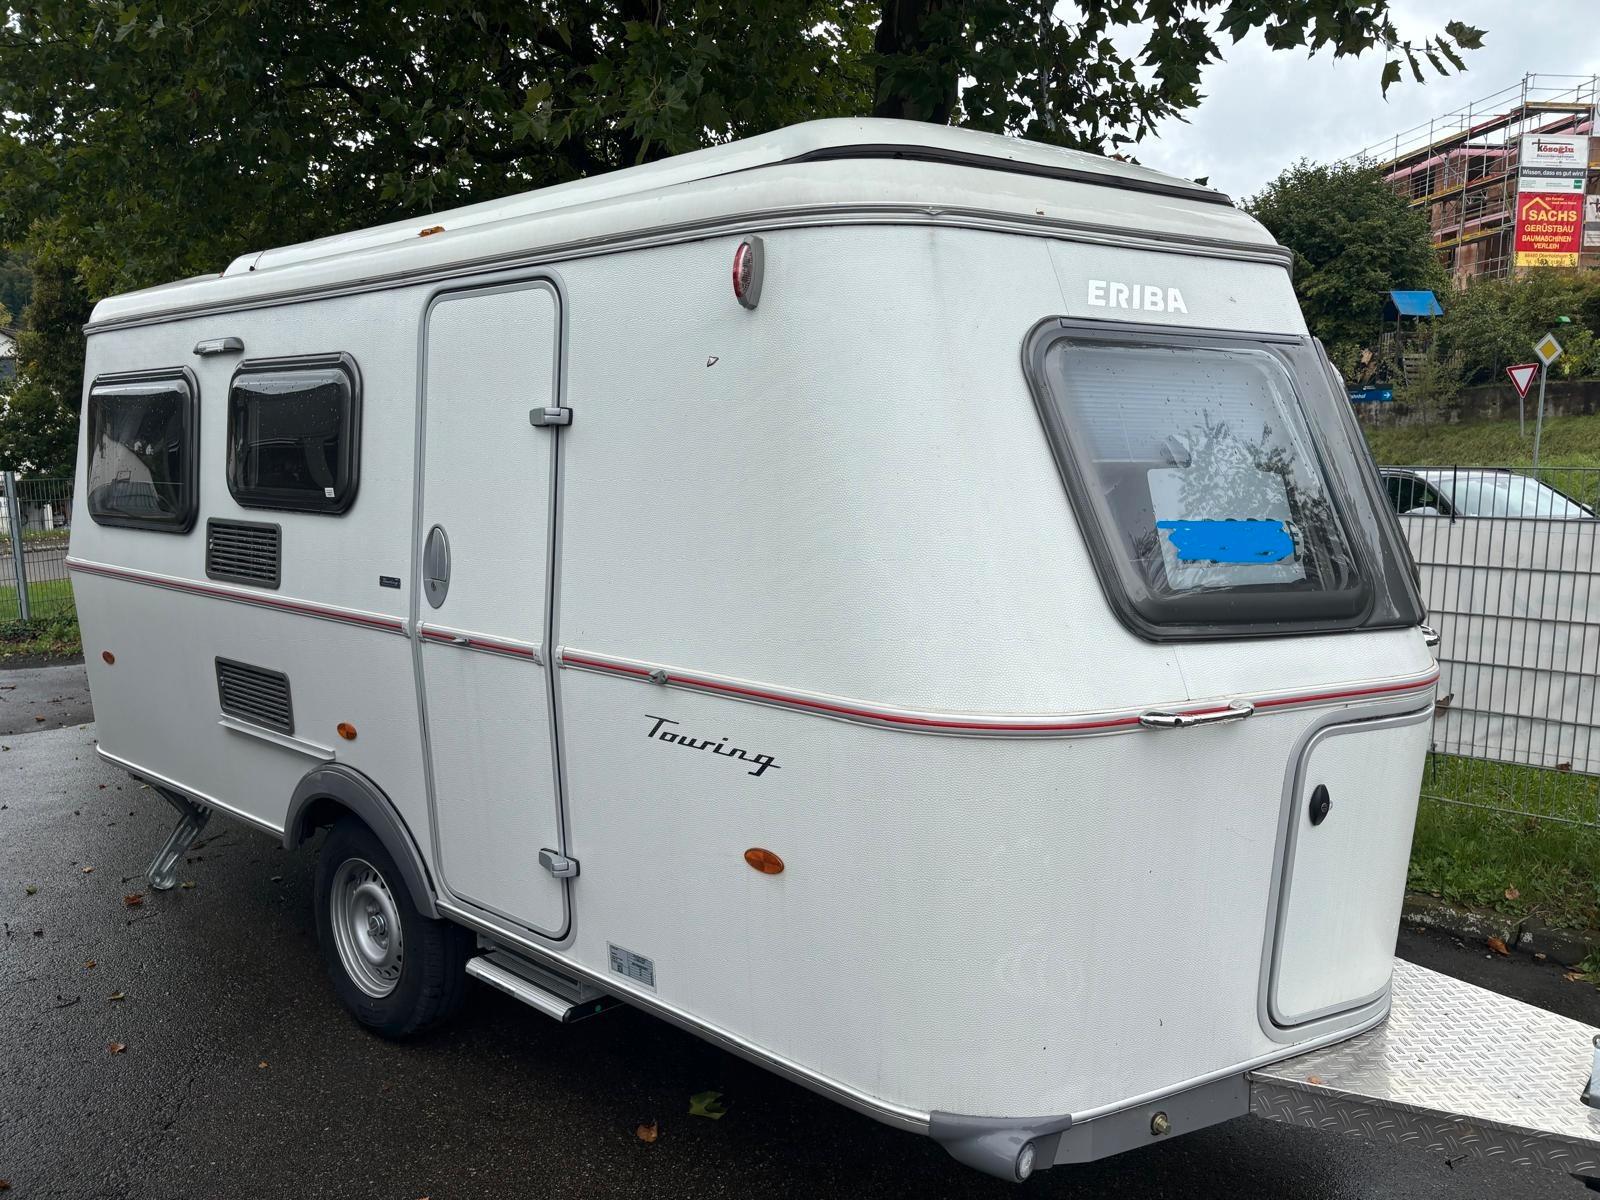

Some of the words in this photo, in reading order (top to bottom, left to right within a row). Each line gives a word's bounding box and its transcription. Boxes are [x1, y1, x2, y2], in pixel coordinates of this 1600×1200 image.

[1529, 210, 1577, 221] SACHS
[1525, 223, 1574, 232] GERÜSTBAU
[1087, 279, 1189, 314] ERIBA
[644, 714, 781, 777] Touring
